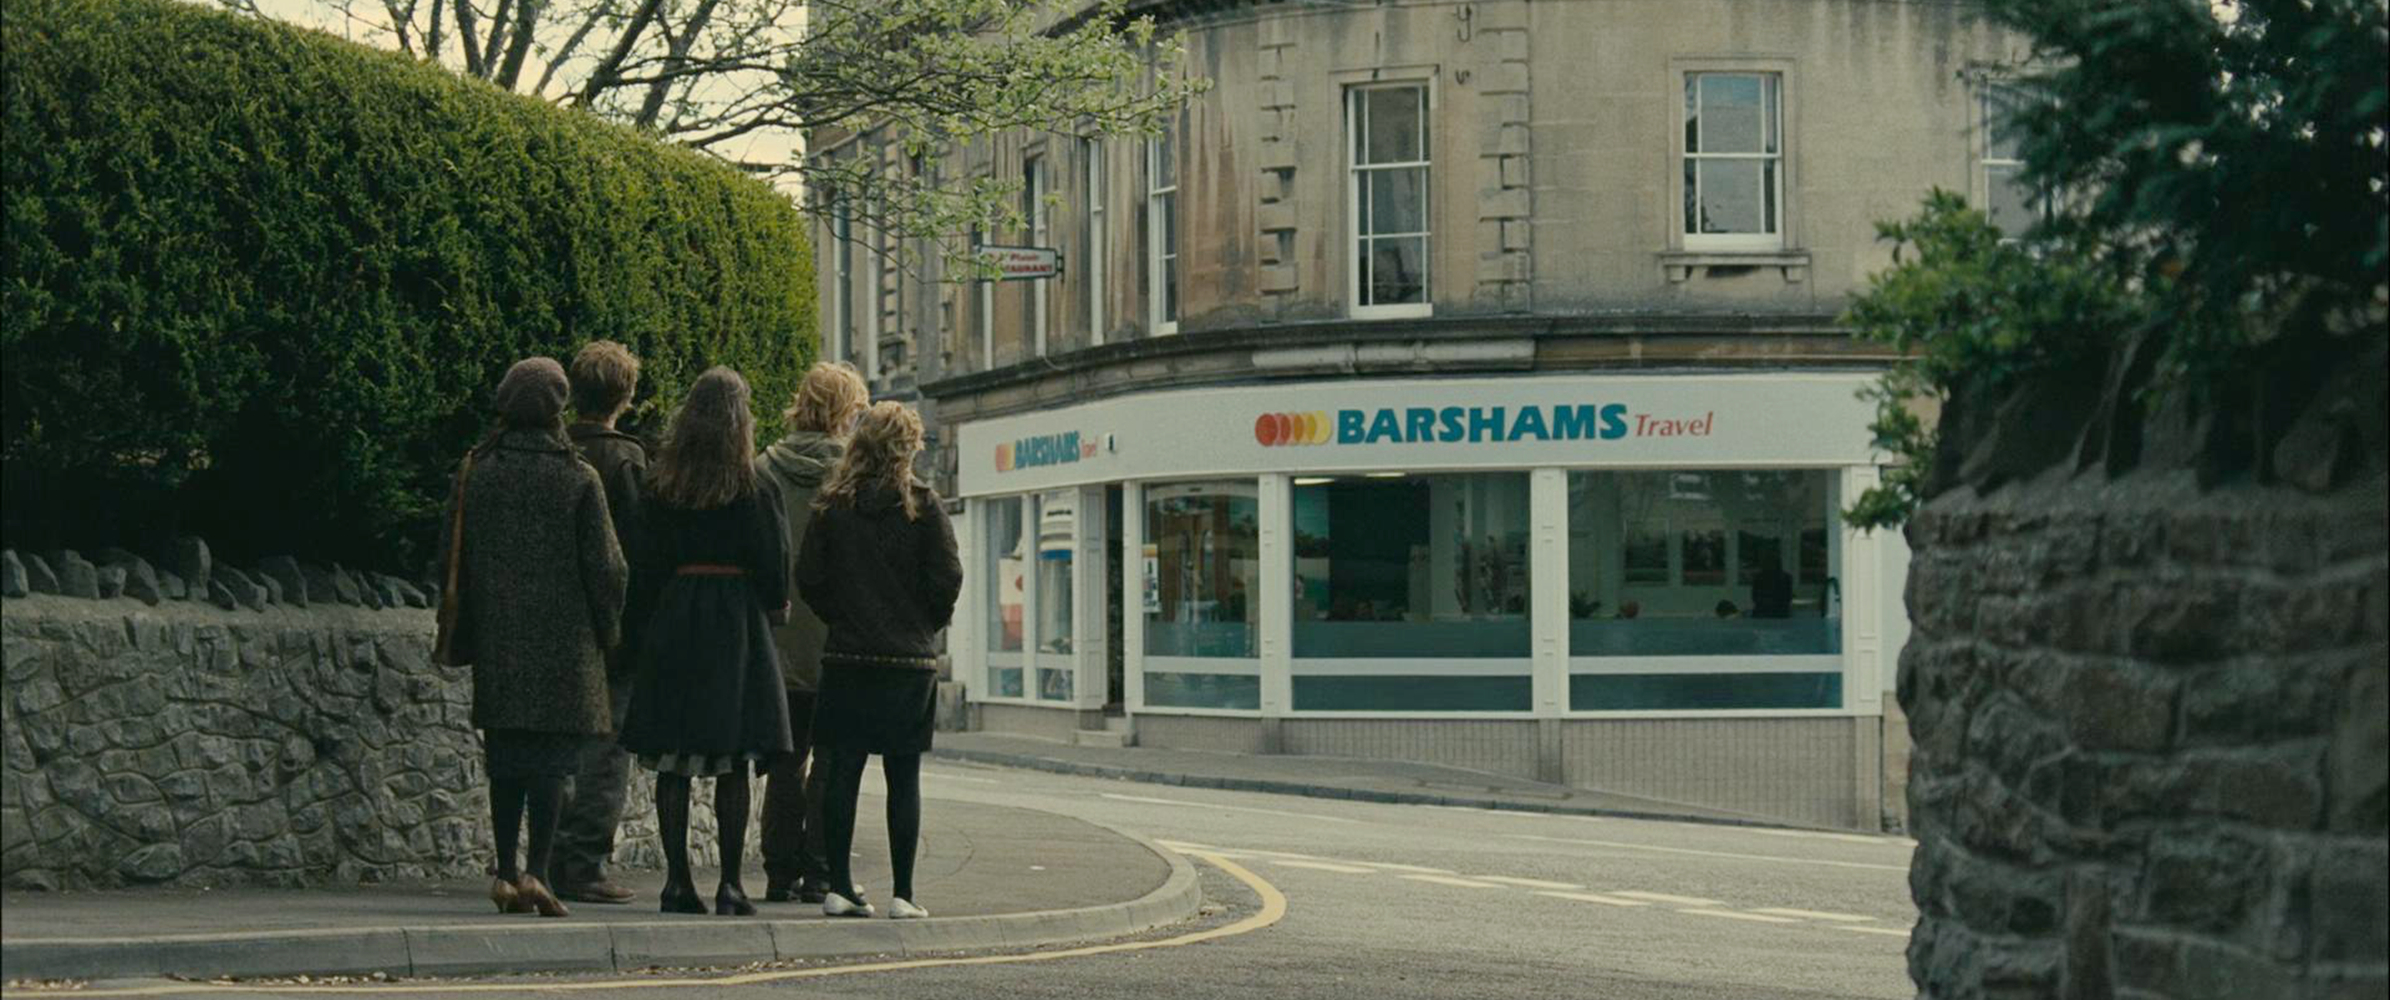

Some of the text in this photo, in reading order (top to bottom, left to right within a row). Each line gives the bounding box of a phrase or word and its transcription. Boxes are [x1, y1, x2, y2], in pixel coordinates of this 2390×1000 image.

[1337, 403, 1714, 444] BARSHAMS Travel
[1015, 430, 1080, 470] BARSHAMS
